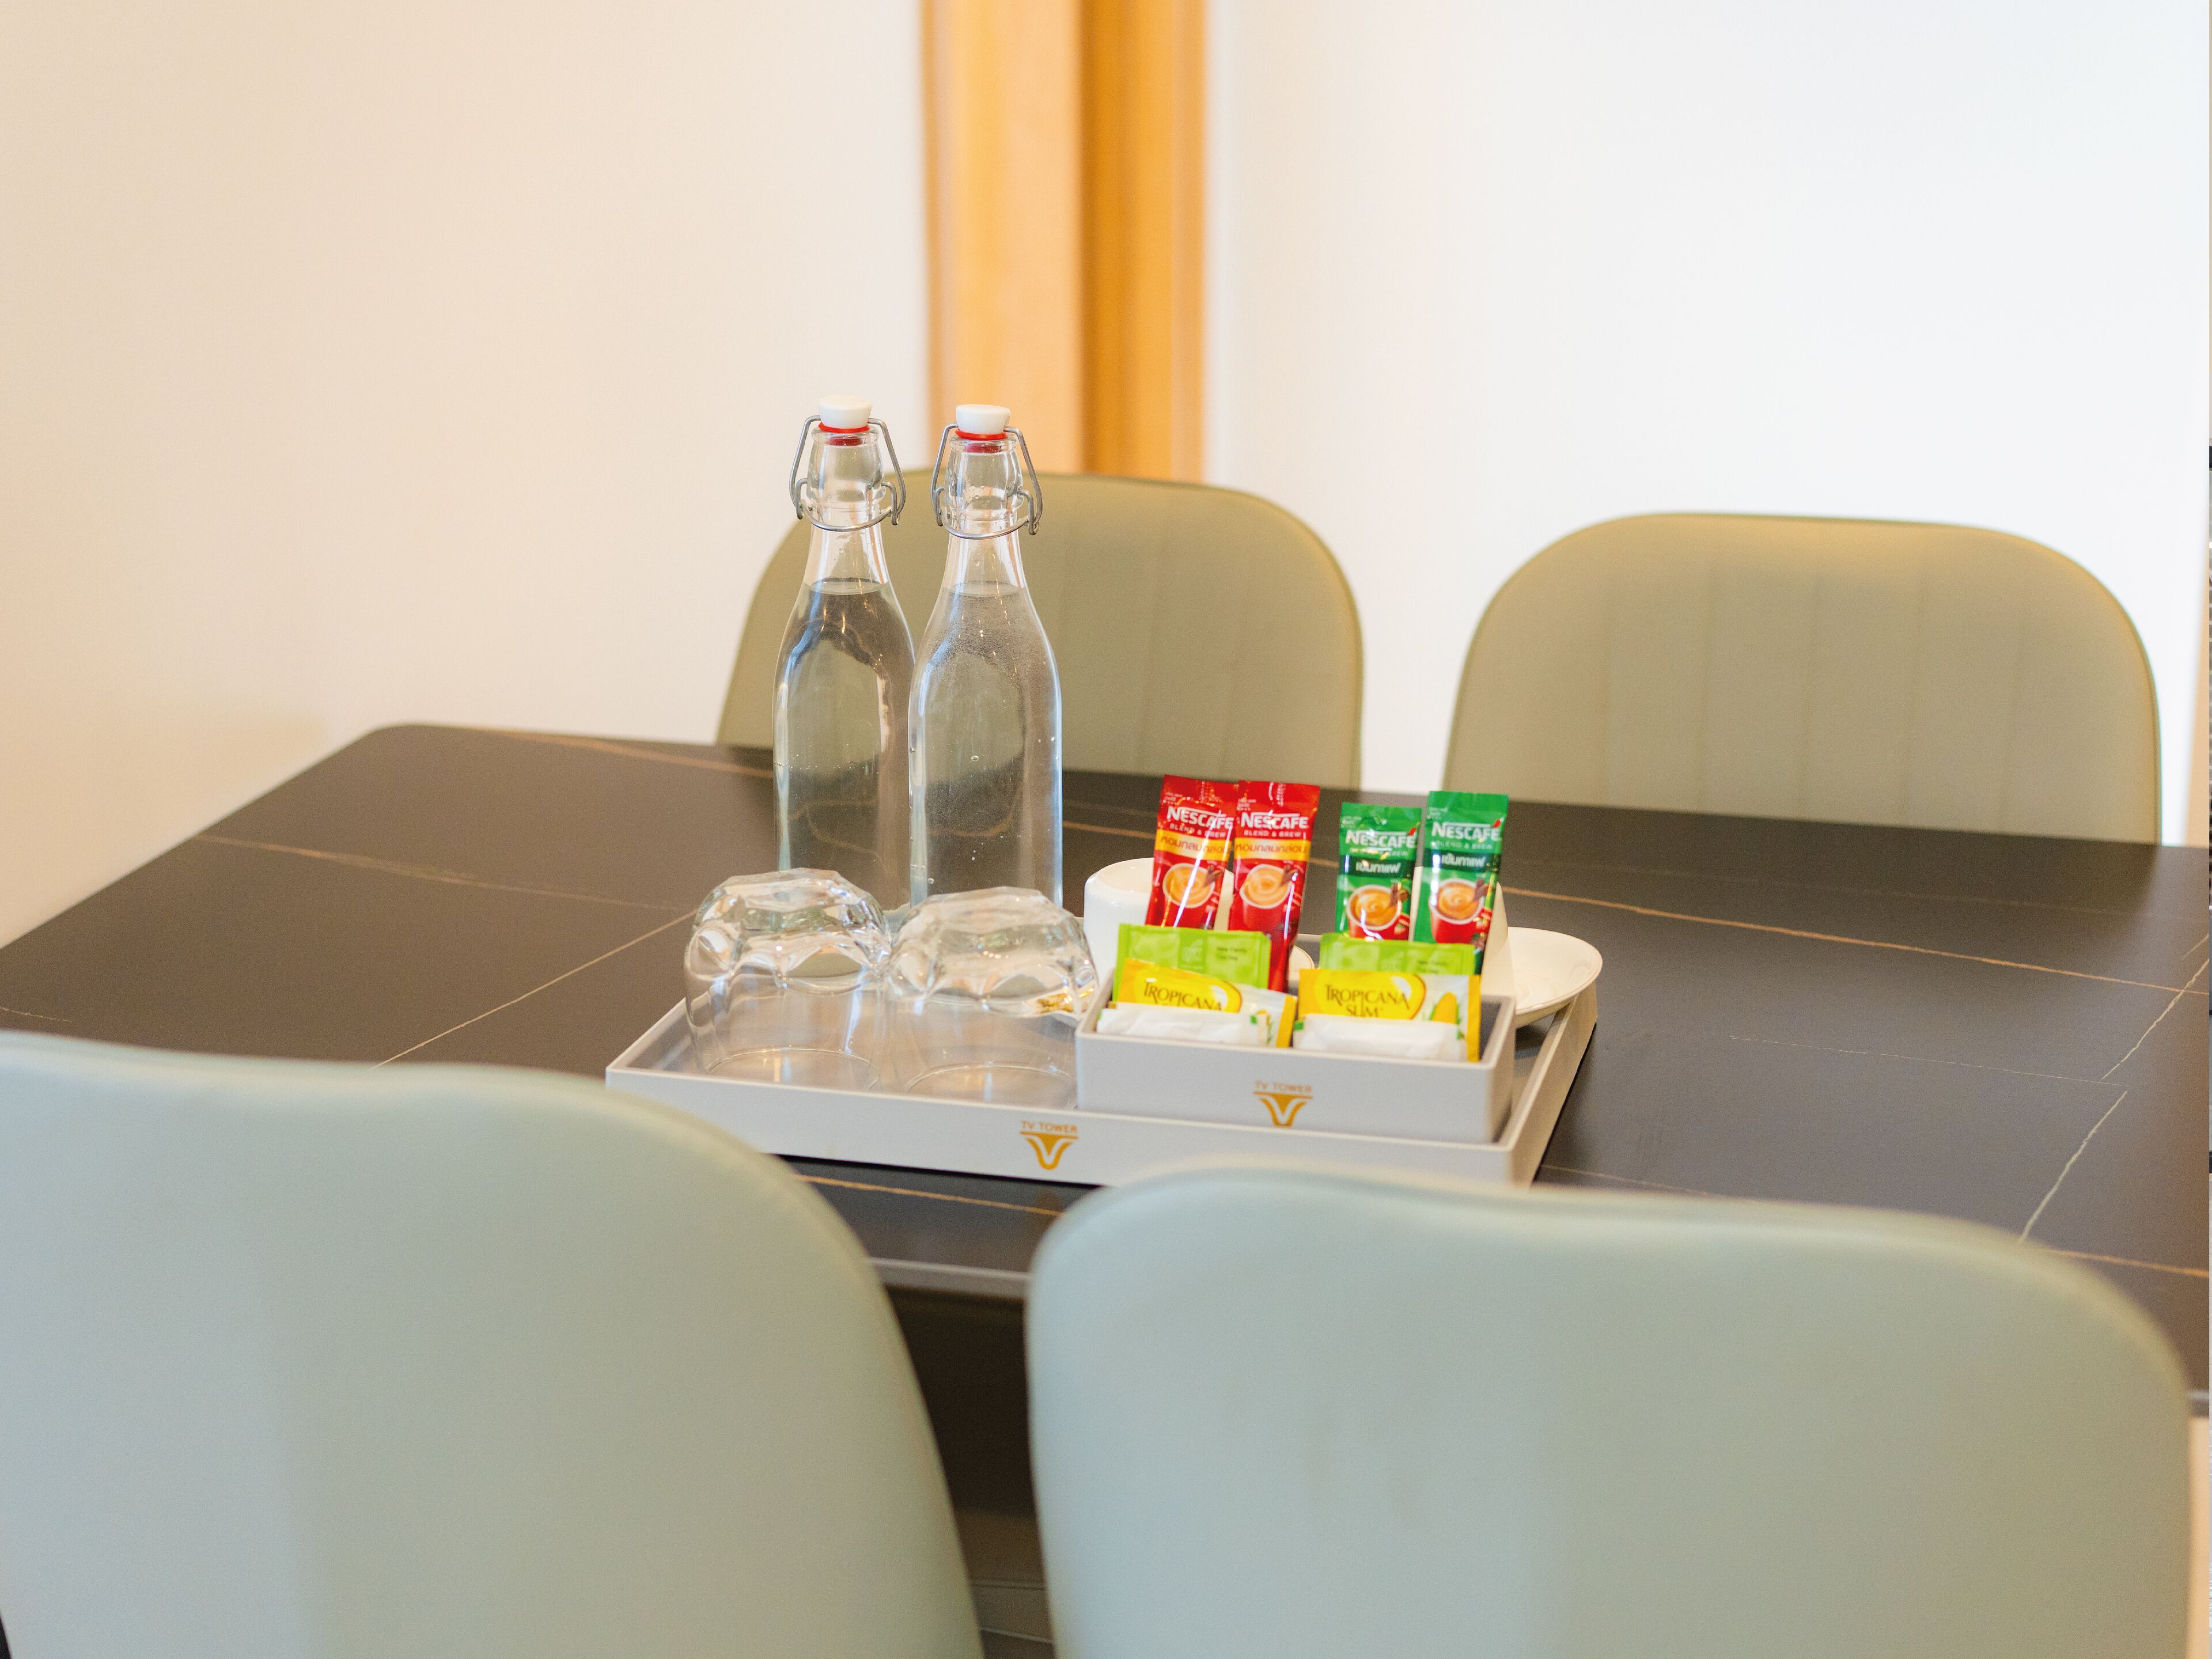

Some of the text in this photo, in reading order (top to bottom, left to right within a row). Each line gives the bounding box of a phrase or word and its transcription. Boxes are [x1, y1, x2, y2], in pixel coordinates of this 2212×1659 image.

[1169, 823, 1195, 834] BLEND
[1144, 979, 1222, 1011] TROPICANA
[1325, 984, 1410, 1010] TROPICANA
[1346, 1003, 1379, 1018] SLIM
[1021, 1120, 1078, 1133] TV TOWER
